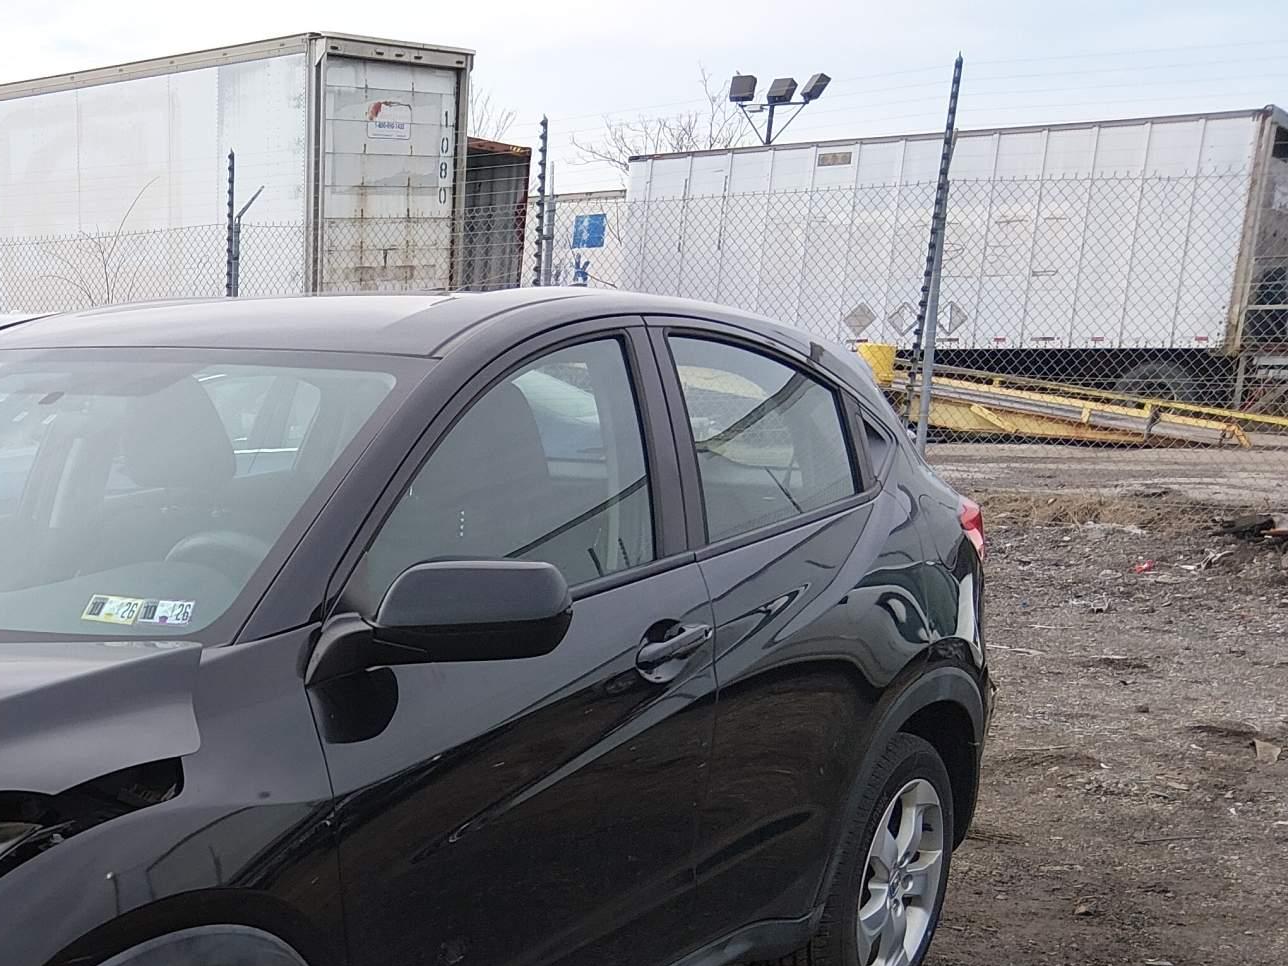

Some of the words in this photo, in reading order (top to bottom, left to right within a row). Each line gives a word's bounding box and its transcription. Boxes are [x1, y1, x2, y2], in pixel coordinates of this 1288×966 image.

[438, 110, 449, 205] 1080
[121, 602, 139, 619] 26
[176, 603, 192, 621] 26
